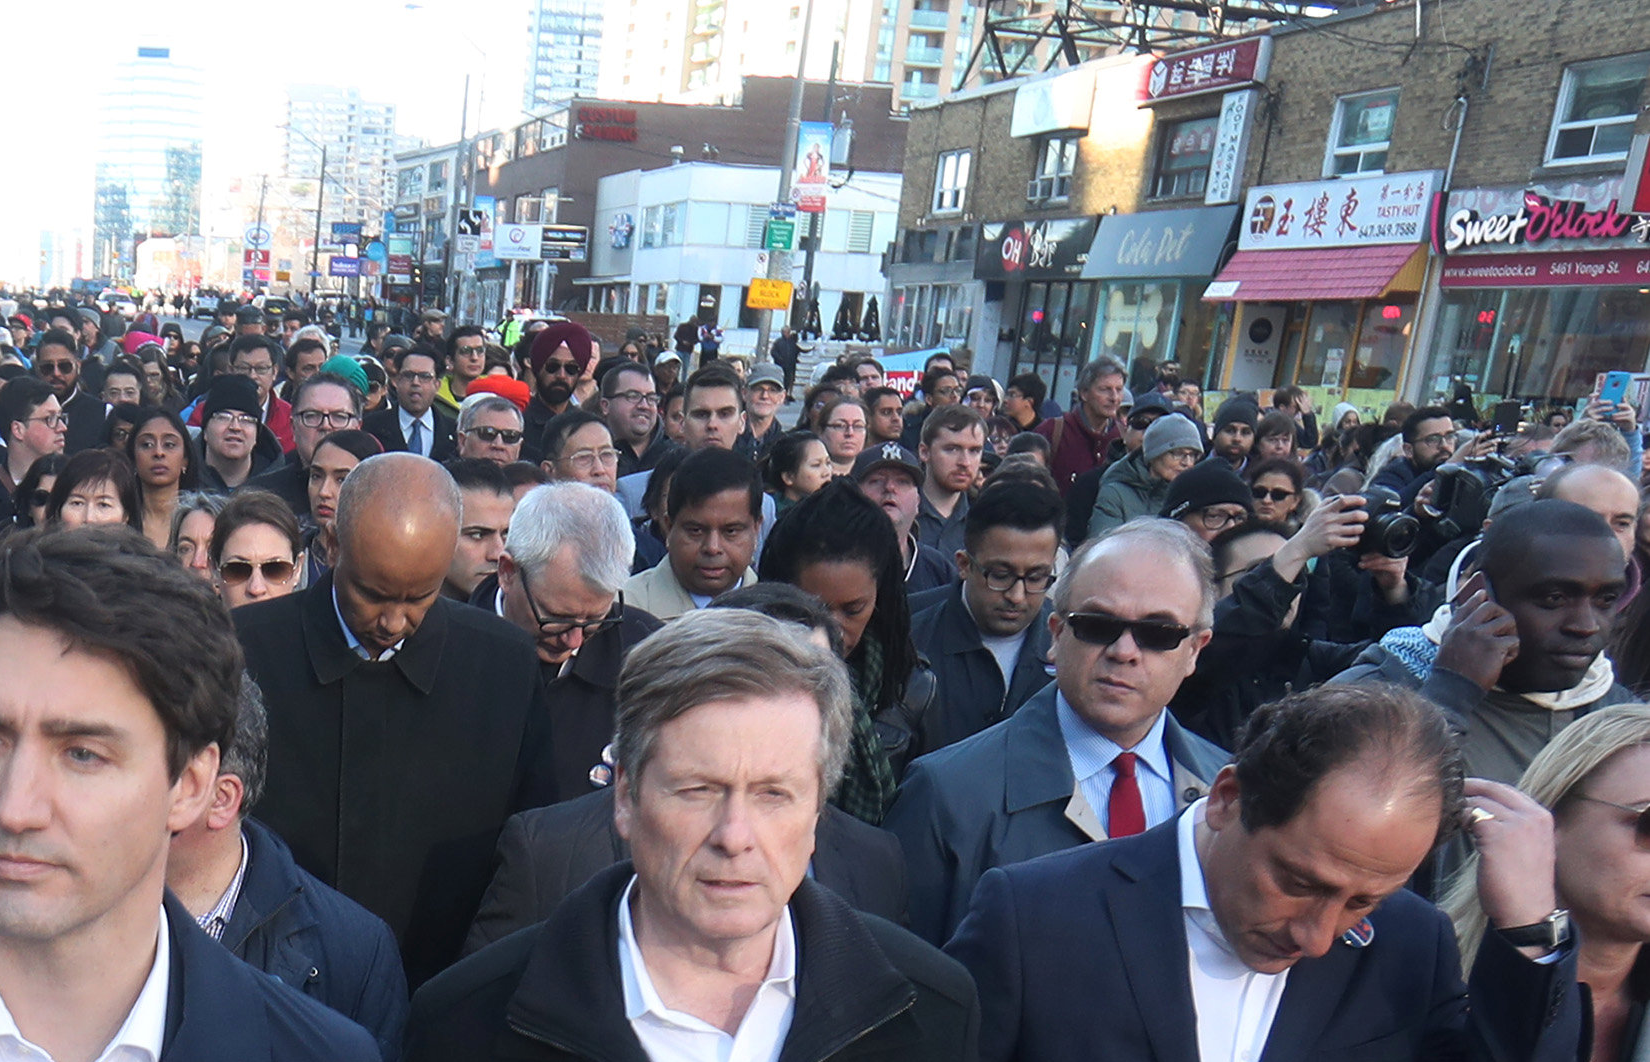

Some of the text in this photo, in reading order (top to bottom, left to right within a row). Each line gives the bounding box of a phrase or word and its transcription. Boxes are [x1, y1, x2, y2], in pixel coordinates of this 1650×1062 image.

[1220, 135, 1238, 199] MASSAGE
[1377, 203, 1421, 219] TASTY HUT
[1444, 207, 1529, 251] Sweet
[1574, 262, 1604, 278] Yonge
